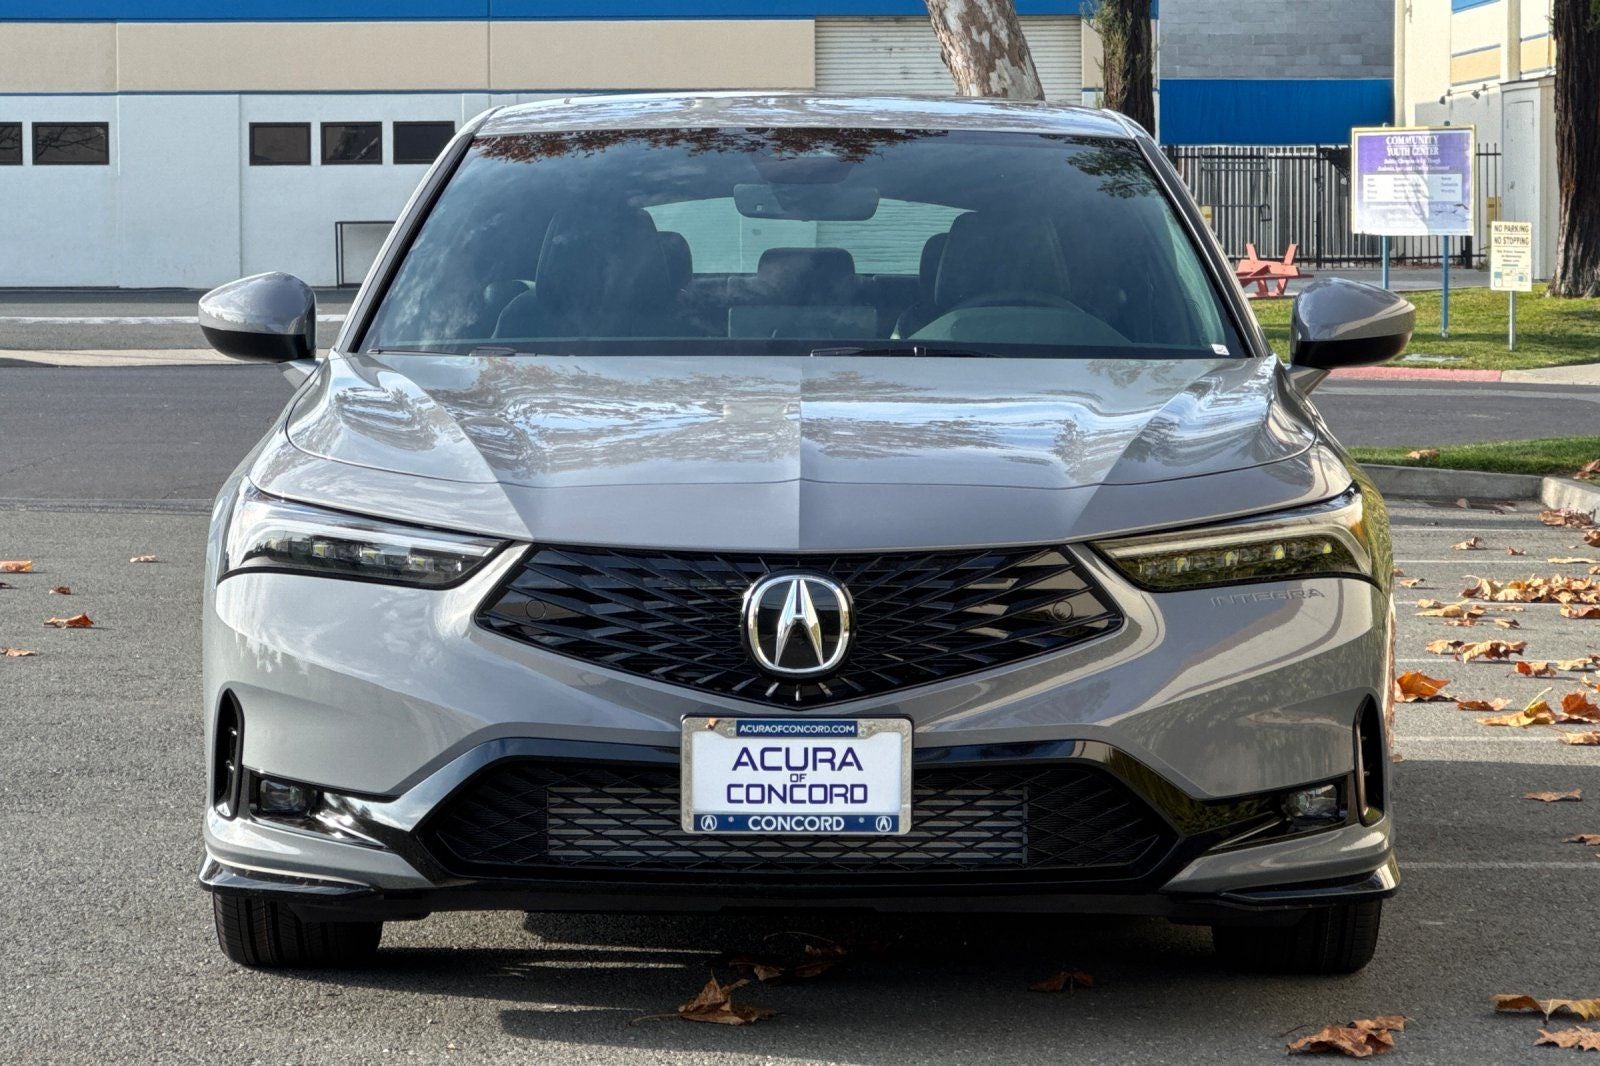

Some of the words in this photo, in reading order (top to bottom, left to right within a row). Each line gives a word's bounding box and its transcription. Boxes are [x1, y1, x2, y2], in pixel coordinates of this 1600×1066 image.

[1385, 135, 1439, 145] COMMUNITY
[1386, 146, 1410, 156] YOUTH
[1412, 145, 1439, 156] CENTER
[1494, 224, 1502, 232] NO
[1503, 224, 1529, 233] PARKING
[1494, 236, 1501, 244] NO
[1503, 236, 1529, 245] STOPPING
[1210, 588, 1326, 608] INTEGRA
[739, 724, 855, 734] ACURAOFCONCORD.COM
[731, 746, 864, 772] ACURA
[789, 773, 807, 783] OF
[726, 783, 868, 805] CONCORD
[748, 816, 845, 832] CONCORD
